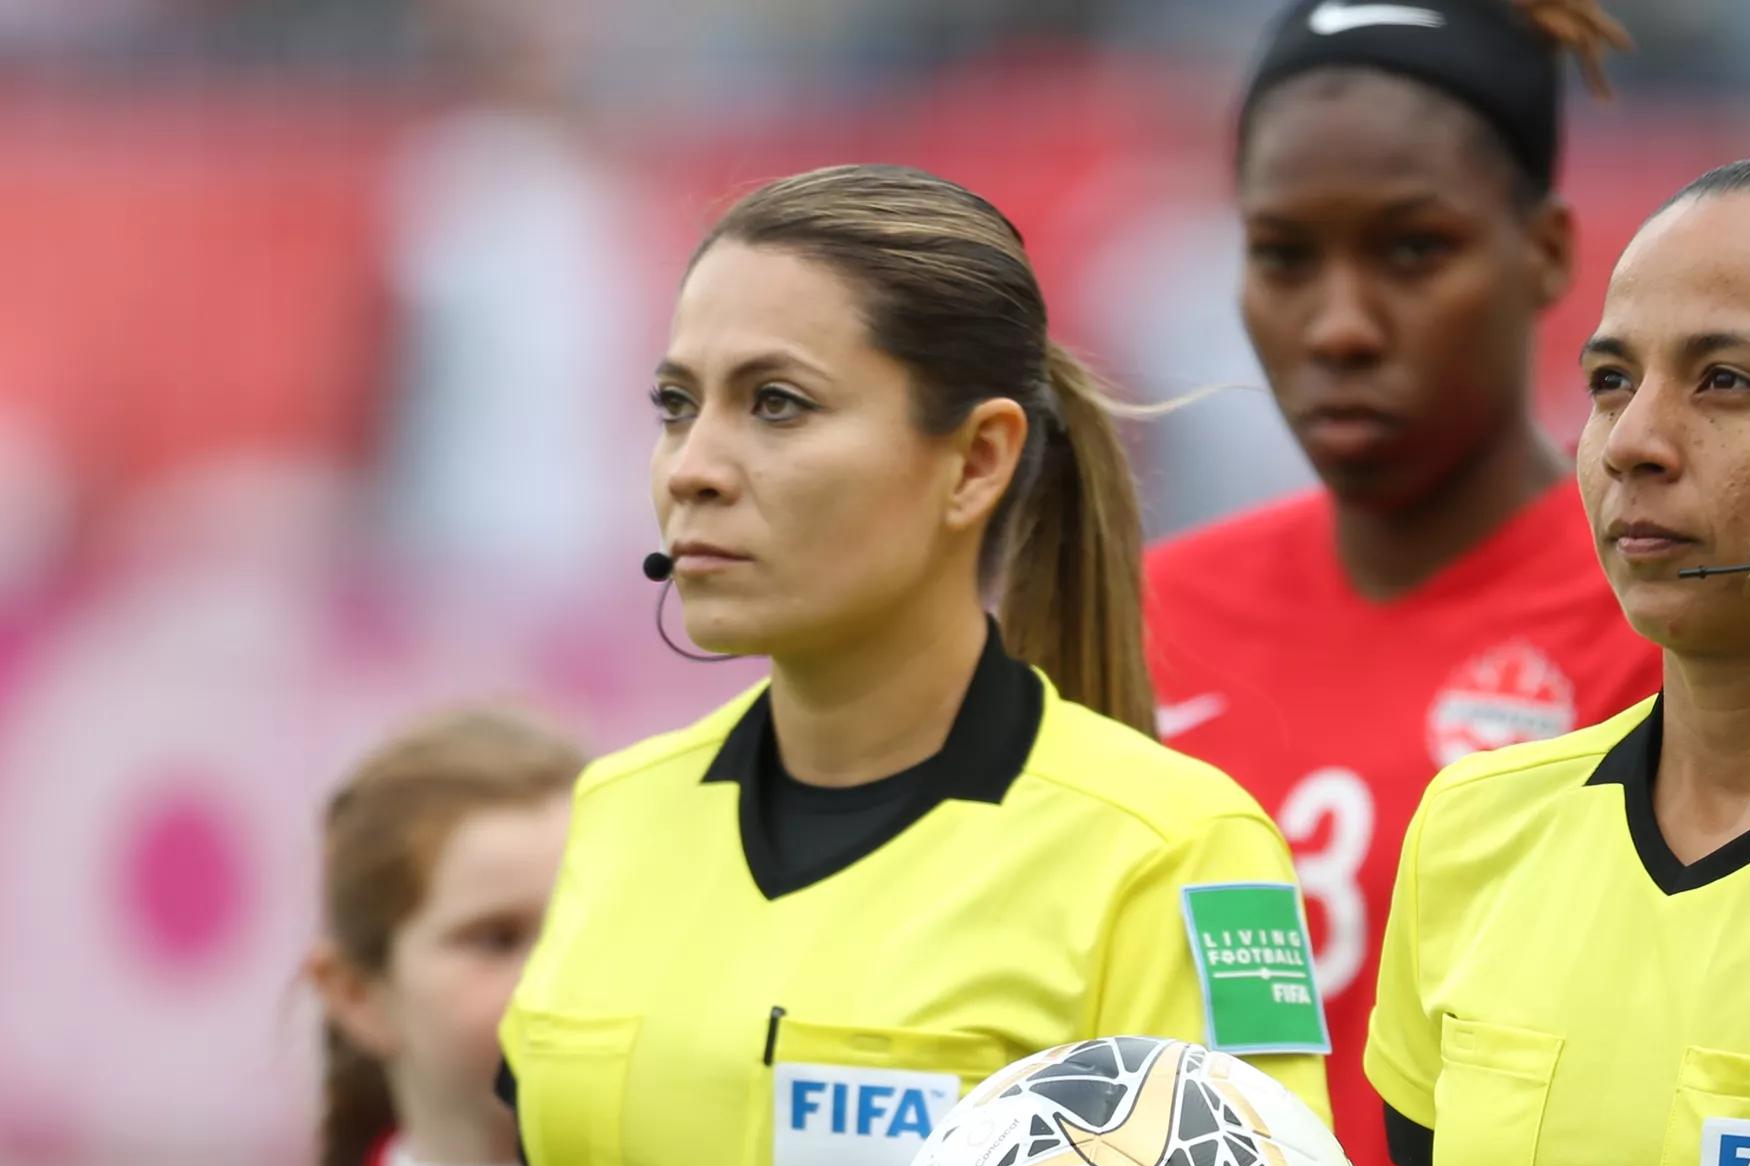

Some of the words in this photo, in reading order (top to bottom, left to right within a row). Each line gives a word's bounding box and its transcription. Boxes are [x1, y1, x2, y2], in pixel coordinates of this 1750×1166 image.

[1203, 929, 1301, 948] LIVING
[1207, 948, 1304, 965] FOOTBALL
[1271, 983, 1311, 1004] FIFA
[790, 1080, 933, 1139] FIFA
